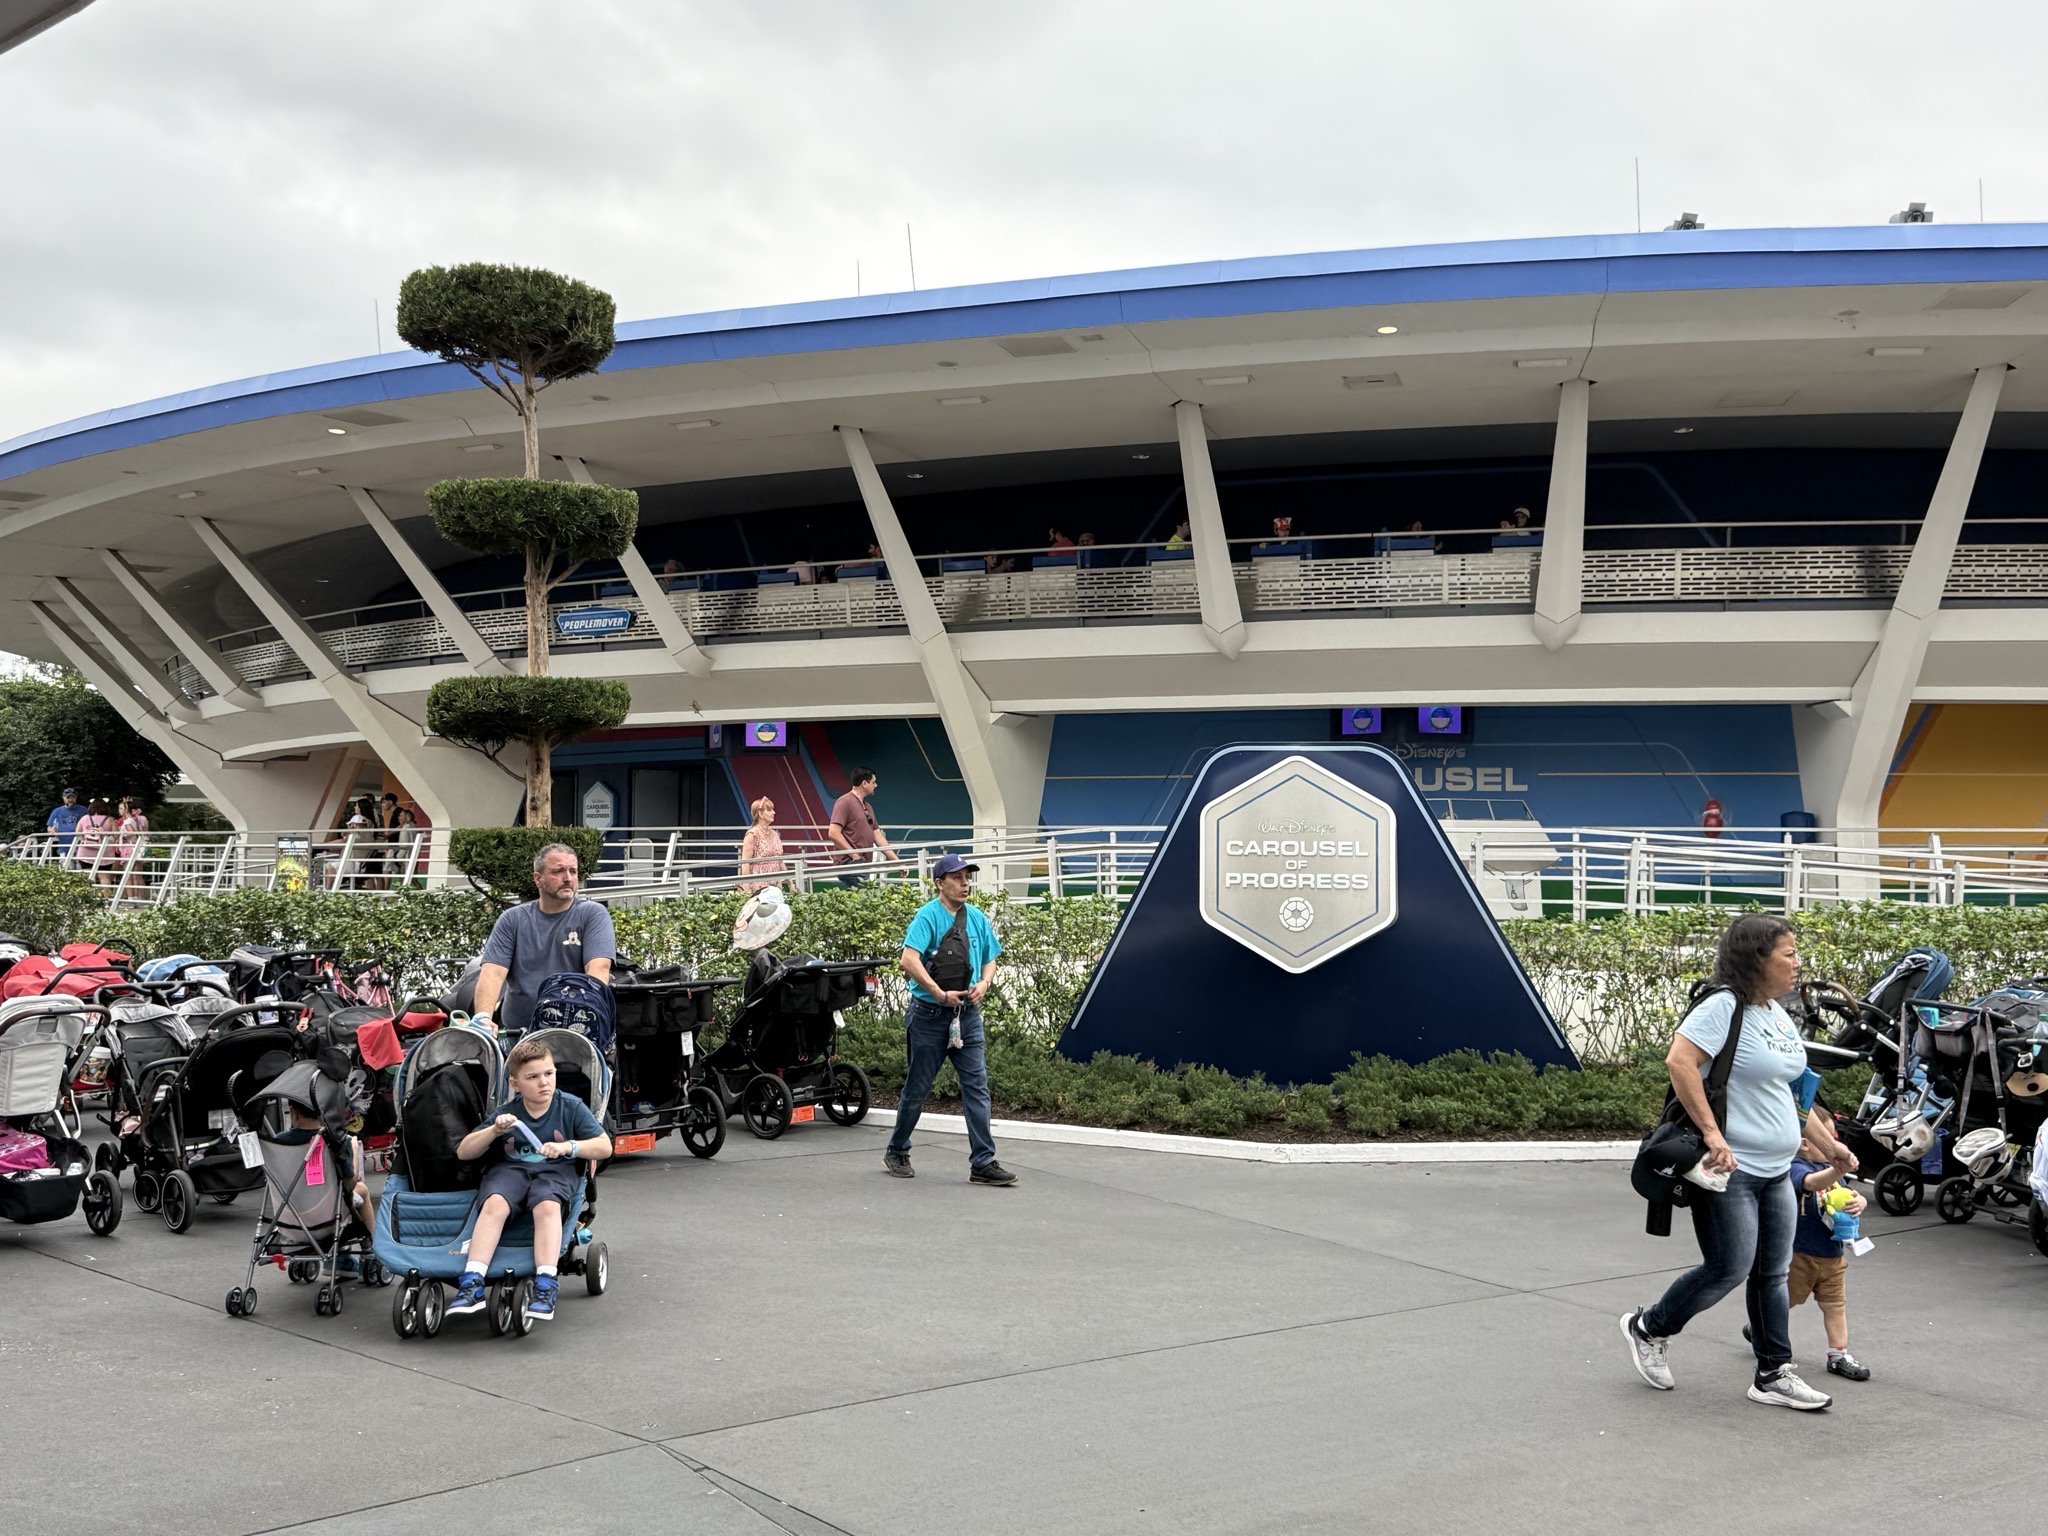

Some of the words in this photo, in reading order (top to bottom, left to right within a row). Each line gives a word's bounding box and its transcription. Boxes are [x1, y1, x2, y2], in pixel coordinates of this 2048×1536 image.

[564, 617, 624, 630] PEOPLEMOVER
[1392, 742, 1466, 766] Disney's
[1226, 840, 1369, 857] CAROUSEL
[1285, 860, 1308, 871] OF
[1225, 872, 1369, 890] PROGRESS
